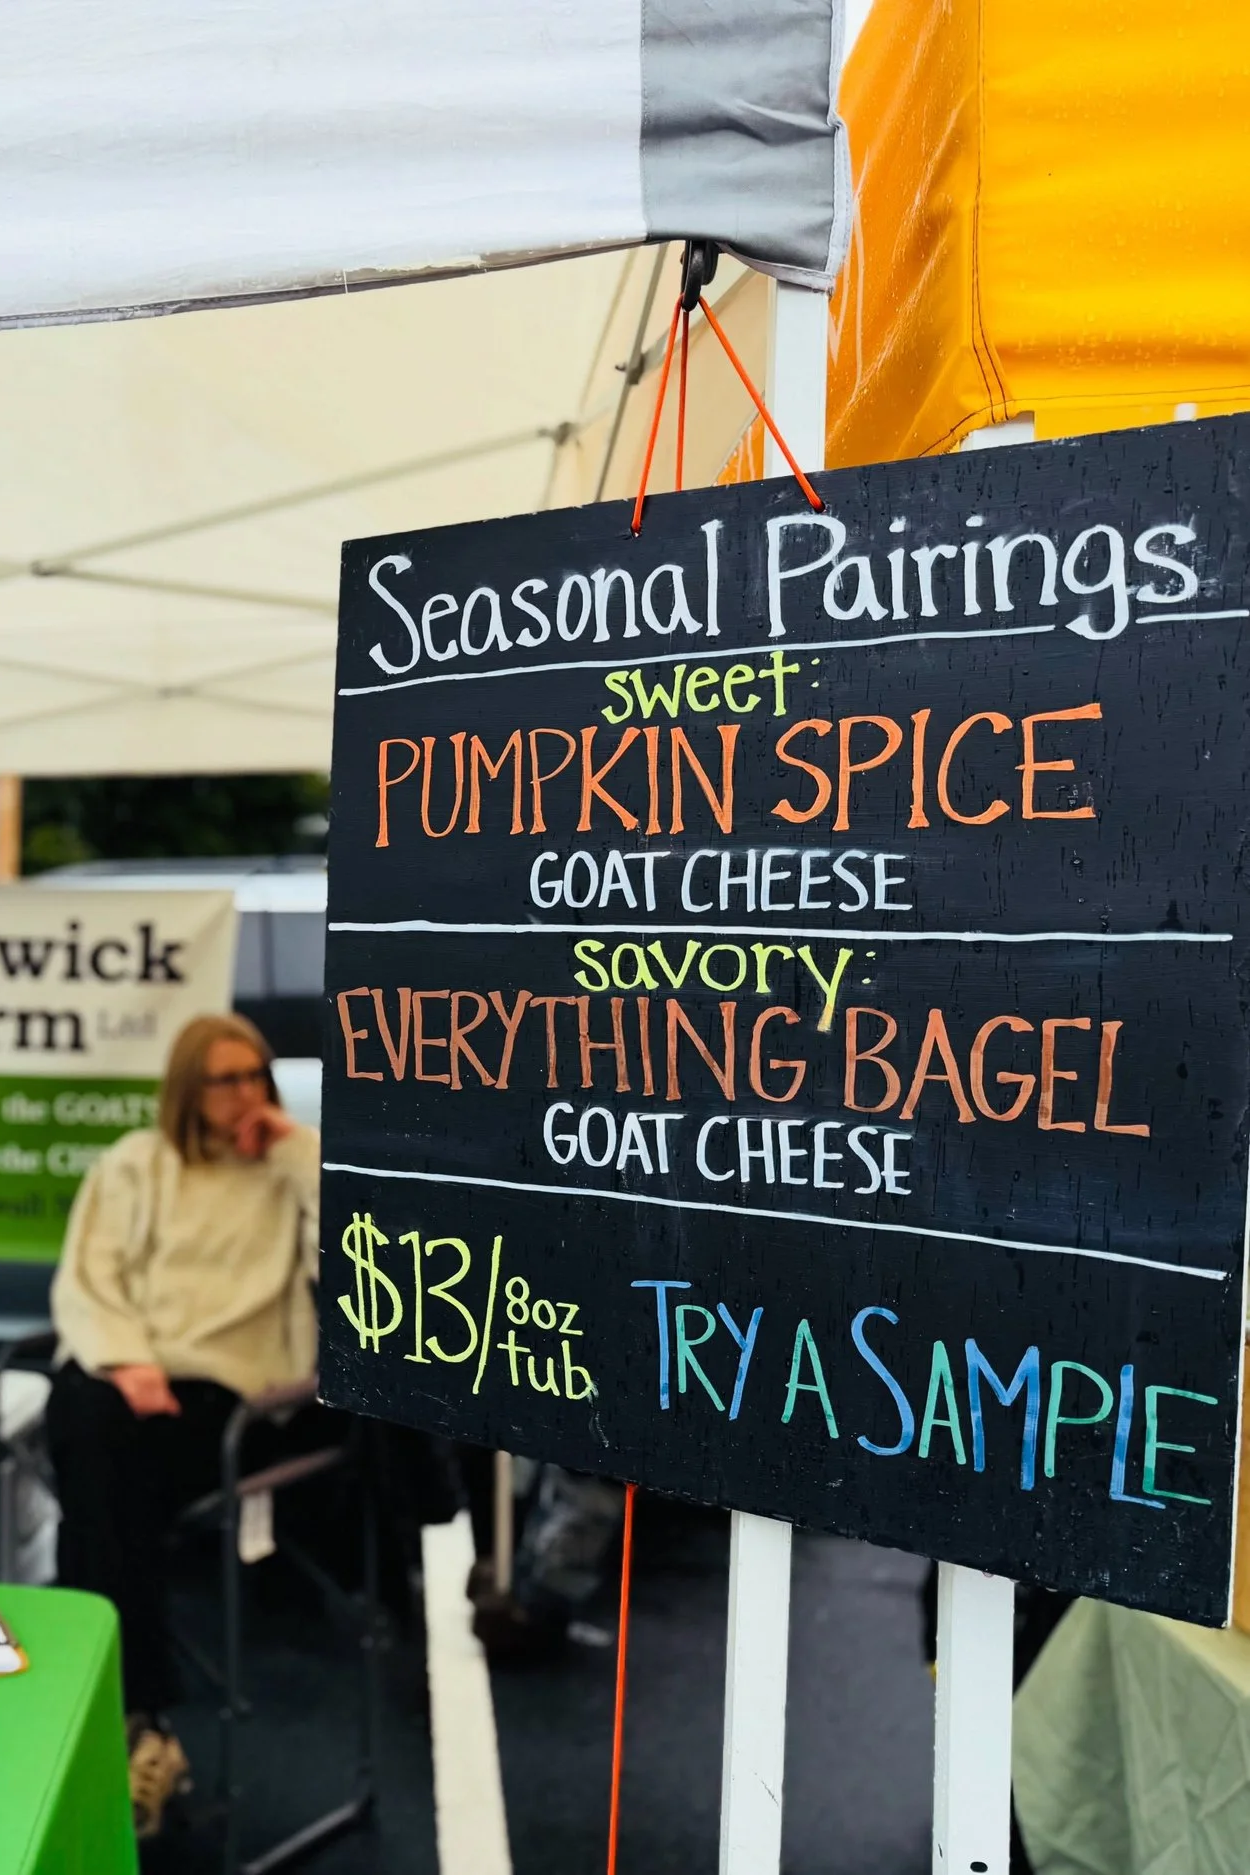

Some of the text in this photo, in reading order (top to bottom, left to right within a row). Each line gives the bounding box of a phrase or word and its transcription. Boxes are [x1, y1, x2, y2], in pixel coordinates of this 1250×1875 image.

[368, 510, 1200, 676] Seasonal Pairings
[601, 649, 822, 725] sweet:
[375, 702, 1103, 848] PUMPKIN SPICE
[529, 848, 914, 913] GOAT CHEESE
[573, 938, 877, 1034] savory:
[336, 986, 1150, 1137] EVERYTHING BAGEL
[543, 1102, 914, 1196] GOAT CHEESE
[497, 1329, 599, 1400] tub
[631, 1280, 1220, 1510] TRY A SAMPLE
